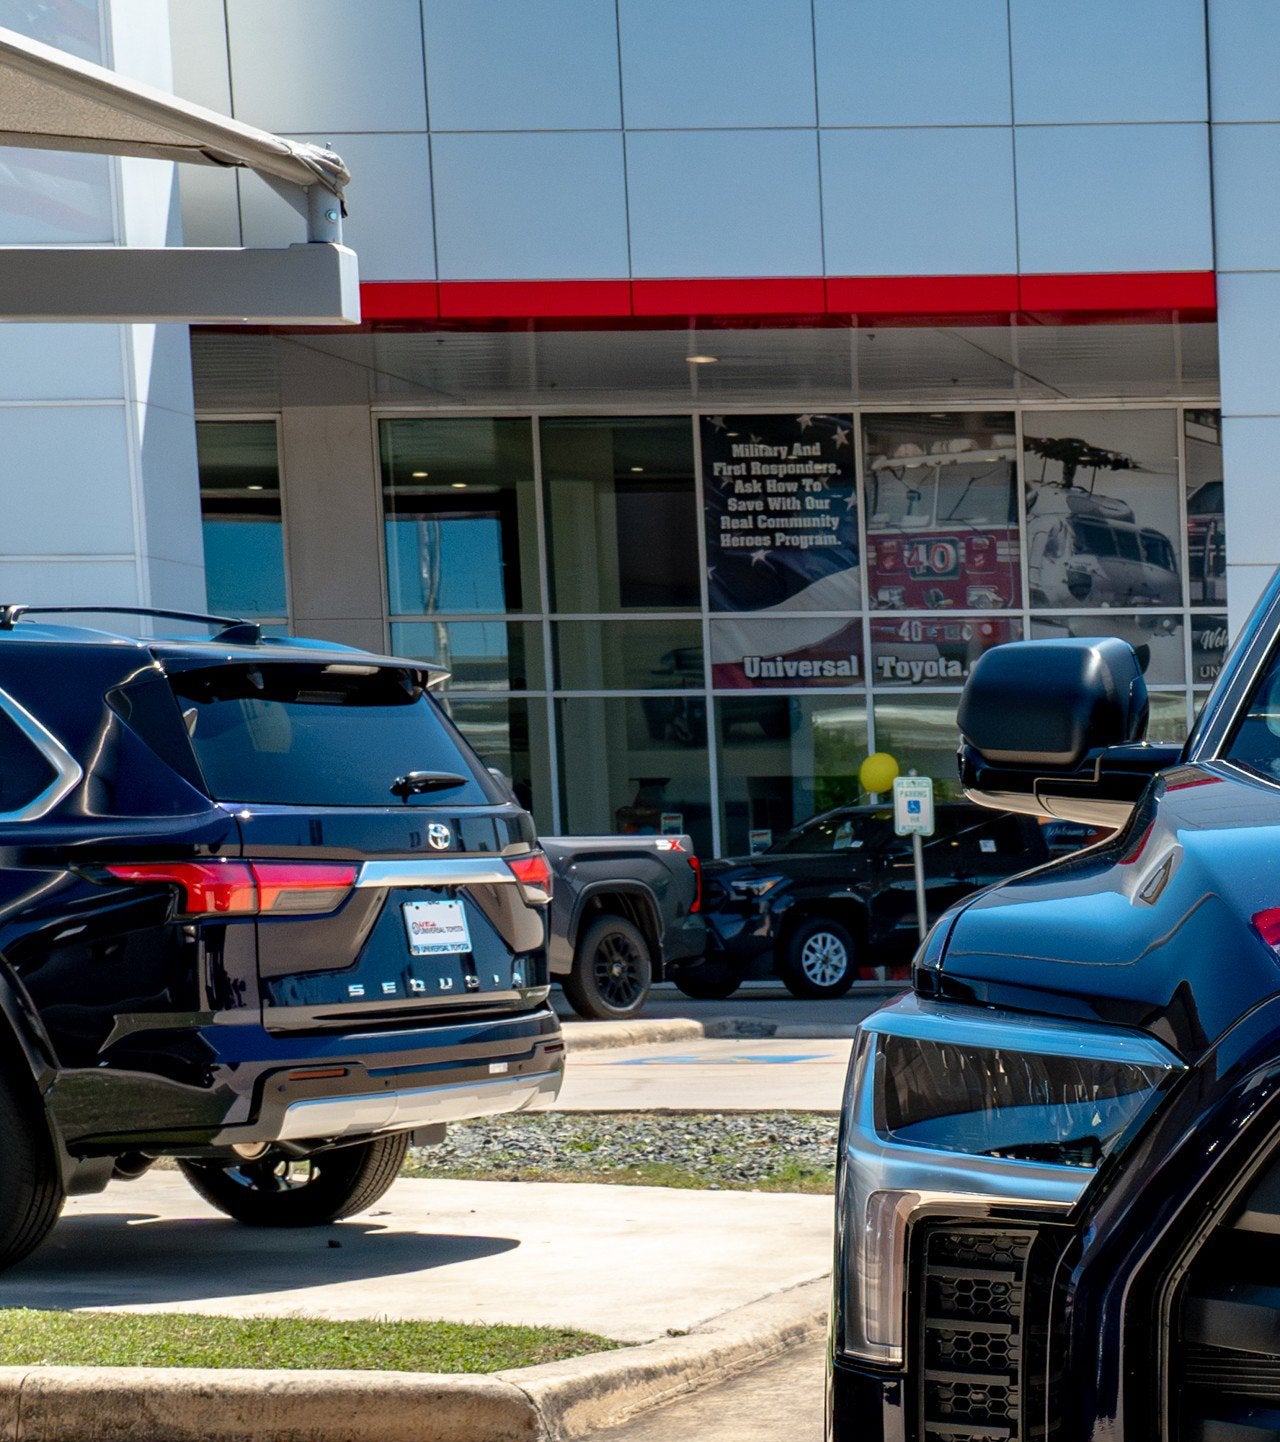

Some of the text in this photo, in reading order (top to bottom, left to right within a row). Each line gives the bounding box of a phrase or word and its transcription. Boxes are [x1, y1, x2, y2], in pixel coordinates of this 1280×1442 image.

[731, 442, 821, 459] Military And
[713, 461, 842, 478] First Responders,
[734, 478, 822, 493] Ask How To
[727, 496, 831, 511] Save With Our
[720, 514, 840, 530] Real Community
[720, 532, 841, 549] Heroes Program.
[904, 543, 957, 574] 40
[899, 620, 922, 641] 40
[743, 655, 859, 678] Universal
[348, 971, 522, 998] SEQUOIA
